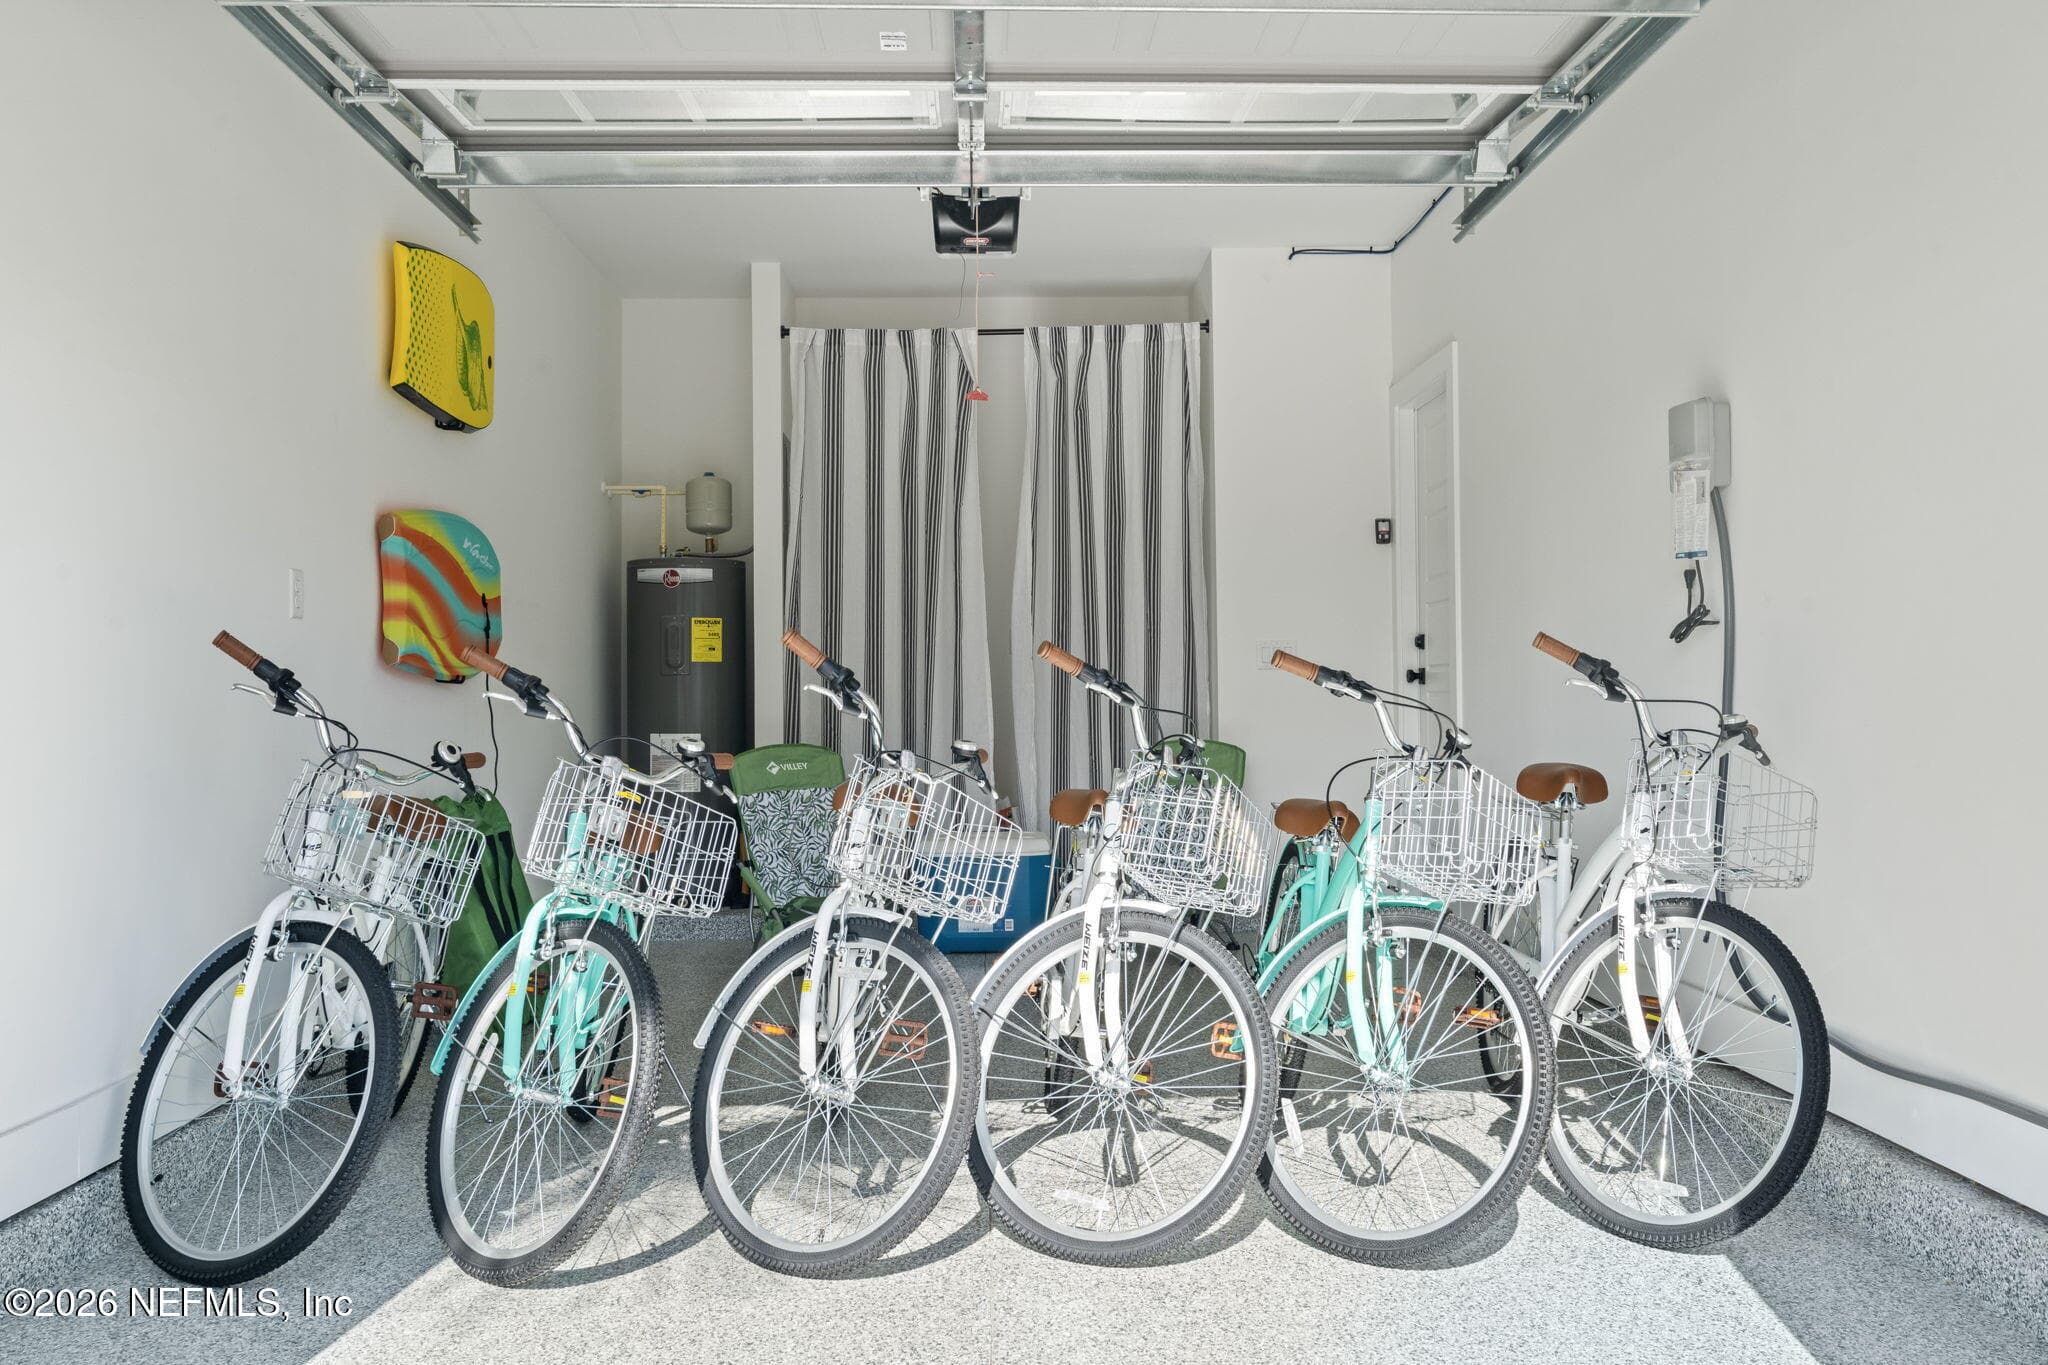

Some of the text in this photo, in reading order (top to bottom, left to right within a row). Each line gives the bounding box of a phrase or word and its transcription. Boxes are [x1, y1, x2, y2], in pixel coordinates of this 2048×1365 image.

[780, 762, 808, 771] VILLEY
[805, 930, 819, 979] WEIZE
[1081, 923, 1092, 970] WEIZE
